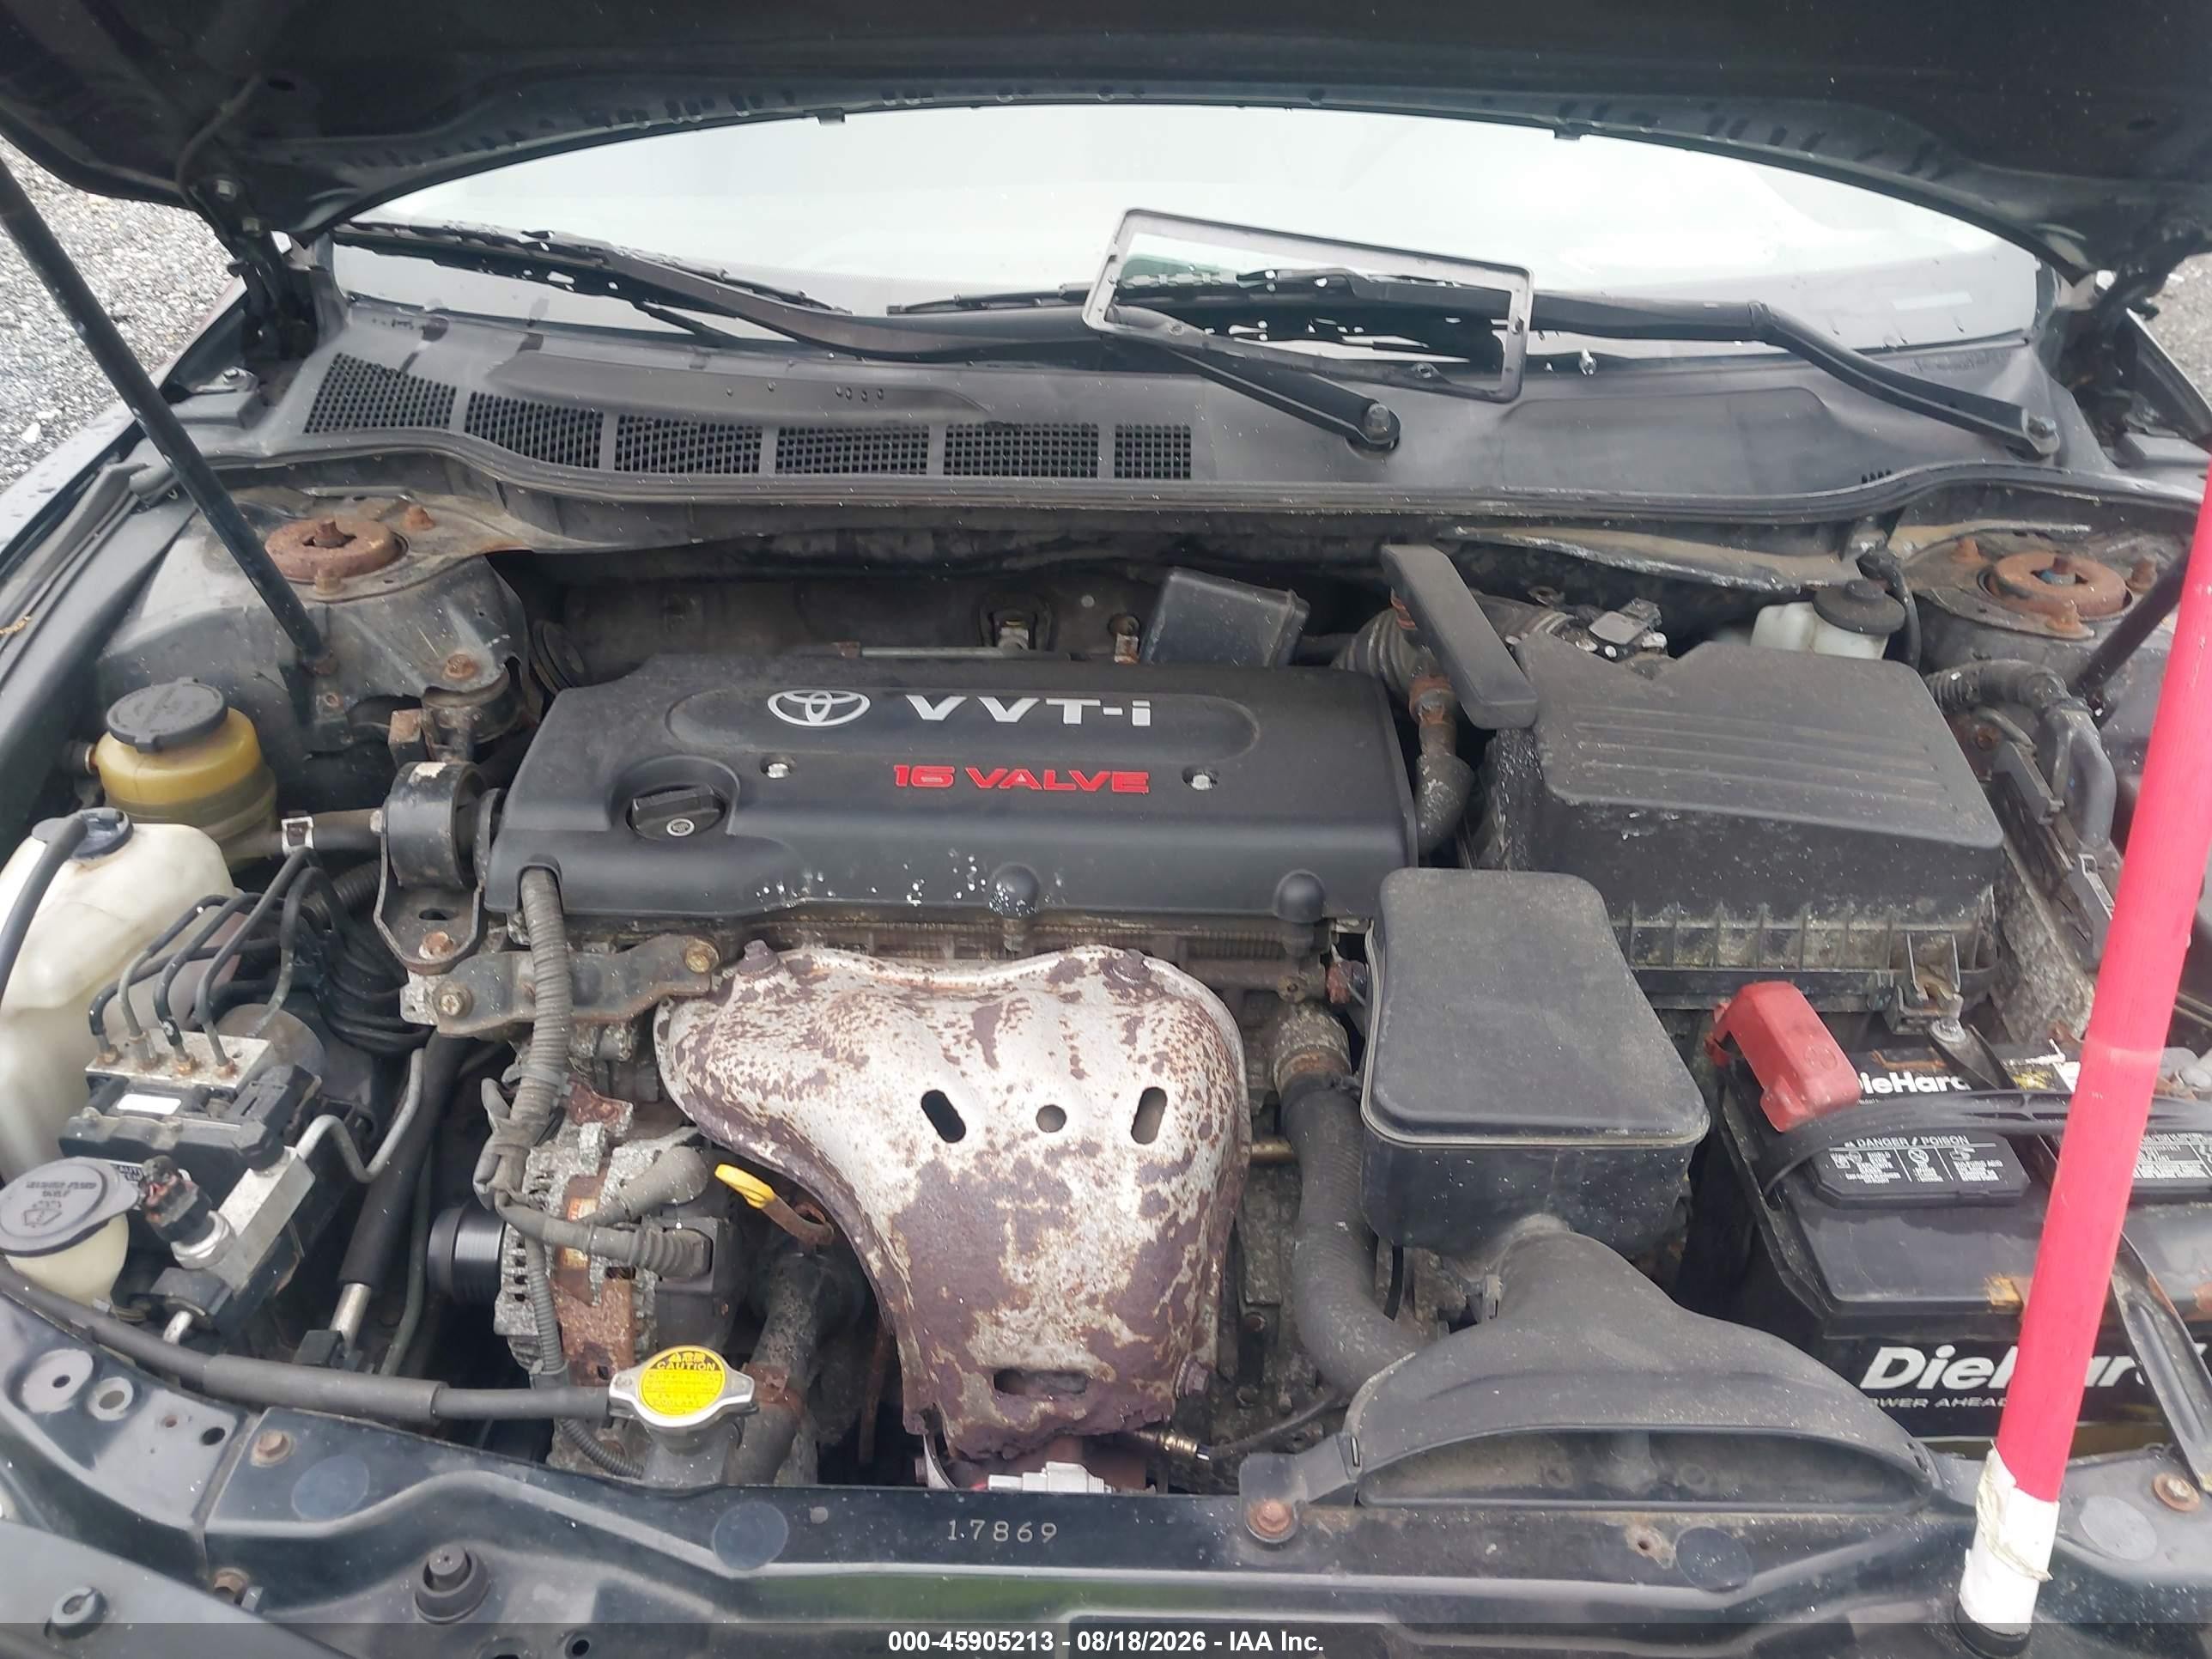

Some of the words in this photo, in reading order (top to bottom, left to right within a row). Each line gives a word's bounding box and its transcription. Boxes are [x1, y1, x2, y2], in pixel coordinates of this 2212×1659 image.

[905, 694, 1152, 727] VVT-i
[894, 765, 955, 788] 16
[964, 767, 1150, 793] VALVE
[1858, 1072, 1972, 1095] ieHard
[1855, 1136, 1909, 1148] DANGER
[1920, 1135, 1970, 1146] POISON
[657, 1361, 715, 1371] CAUTION
[1869, 1397, 1929, 1408] WER
[946, 1519, 1059, 1543] 17869
